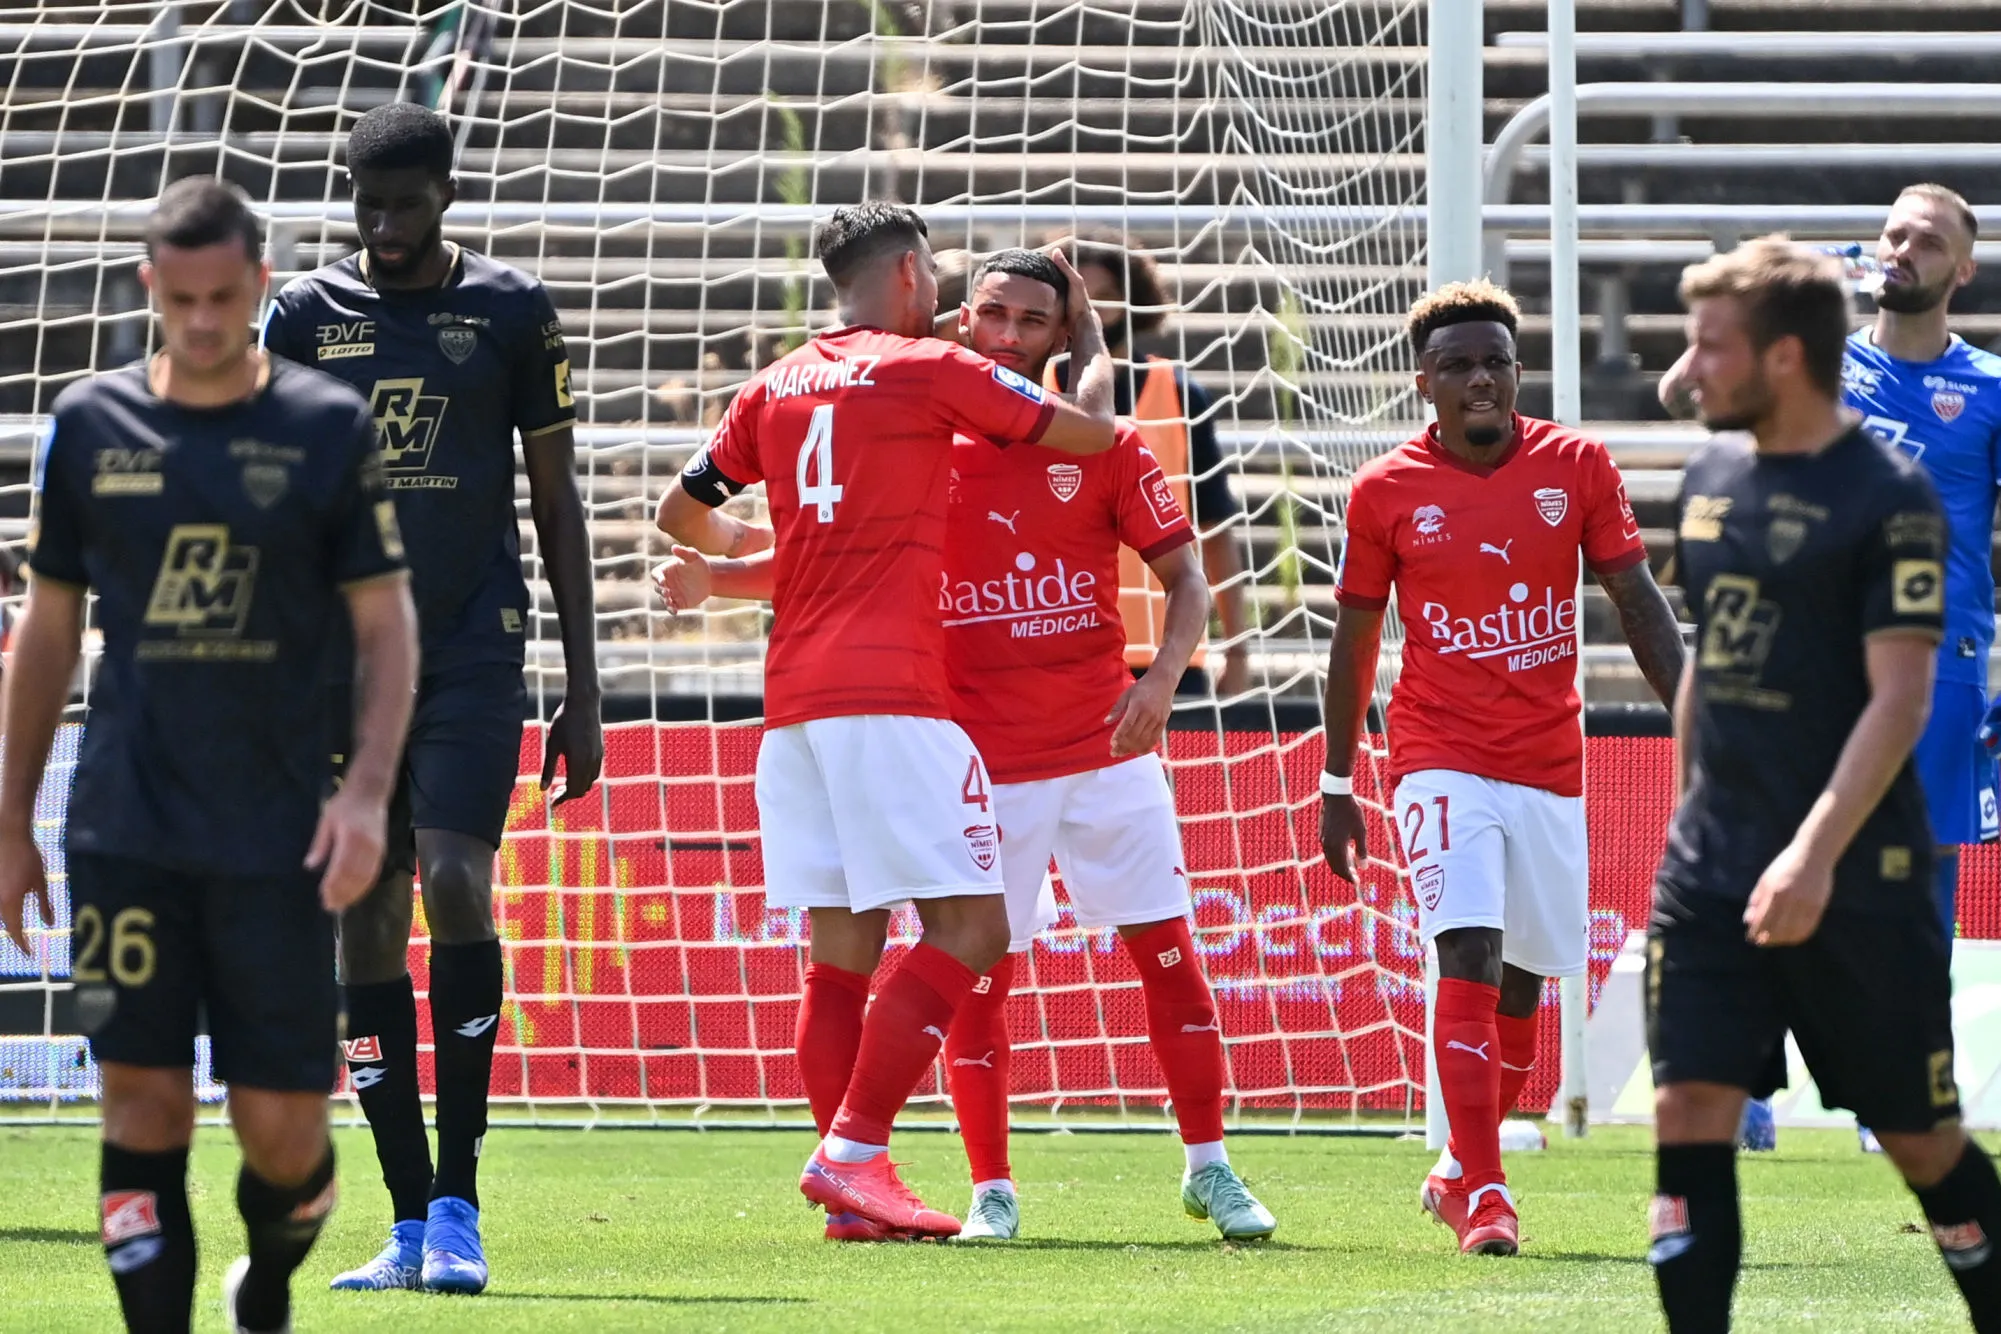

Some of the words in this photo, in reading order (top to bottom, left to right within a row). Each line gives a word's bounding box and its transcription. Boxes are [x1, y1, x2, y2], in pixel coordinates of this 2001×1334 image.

[315, 321, 376, 344] DVF
[331, 345, 371, 355] LOTTO
[765, 354, 881, 402] MARTINEZ
[398, 477, 457, 489] MARTIN
[796, 403, 844, 523] 4
[1010, 611, 1101, 638] MÉDICAL
[1422, 582, 1577, 650] Bastide
[1507, 639, 1575, 673] MÉDICAL
[961, 755, 988, 812] 4
[1404, 795, 1450, 863] 21
[72, 905, 156, 987] 26
[820, 1166, 865, 1207] ULTRA
